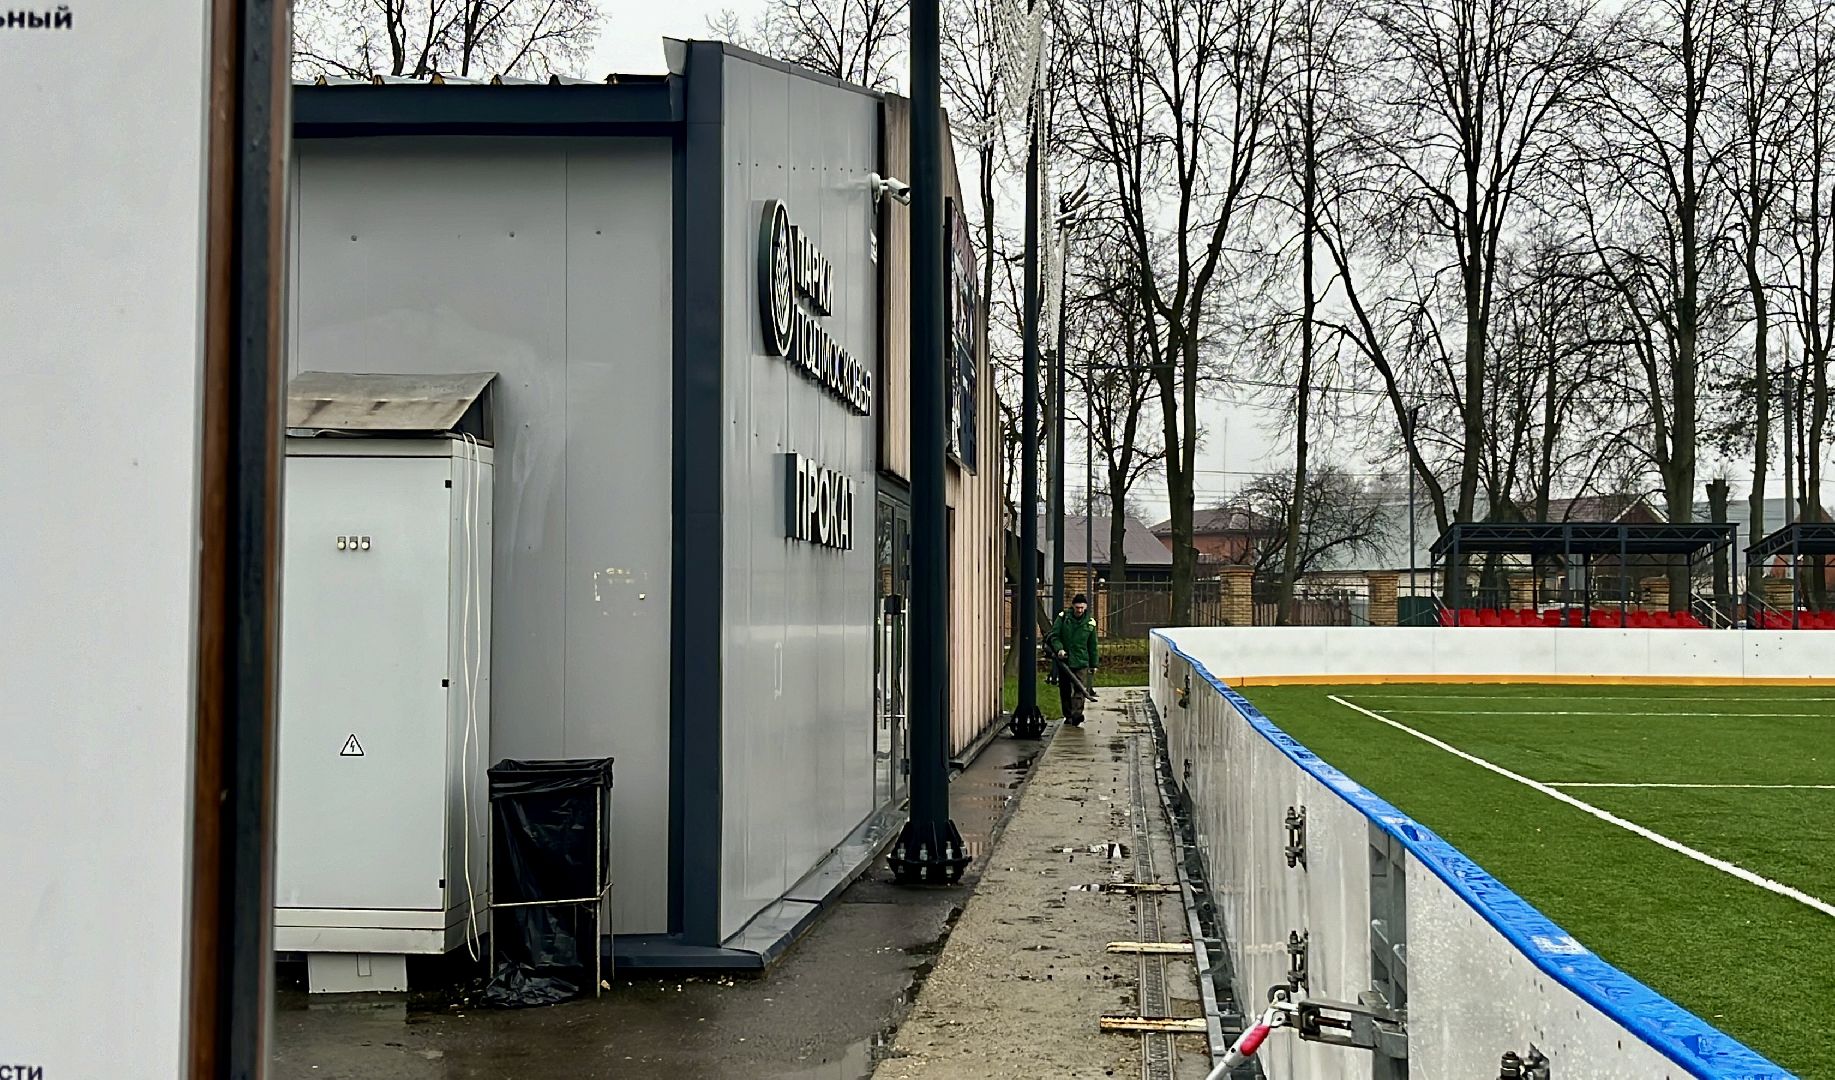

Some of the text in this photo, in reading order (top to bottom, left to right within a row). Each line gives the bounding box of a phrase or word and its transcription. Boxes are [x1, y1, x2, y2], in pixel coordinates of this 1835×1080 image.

[796, 224, 833, 317] ПАРКИ
[795, 303, 872, 416] ПОДМОСКОВЬЯ
[795, 453, 856, 550] ПРОКАТ
